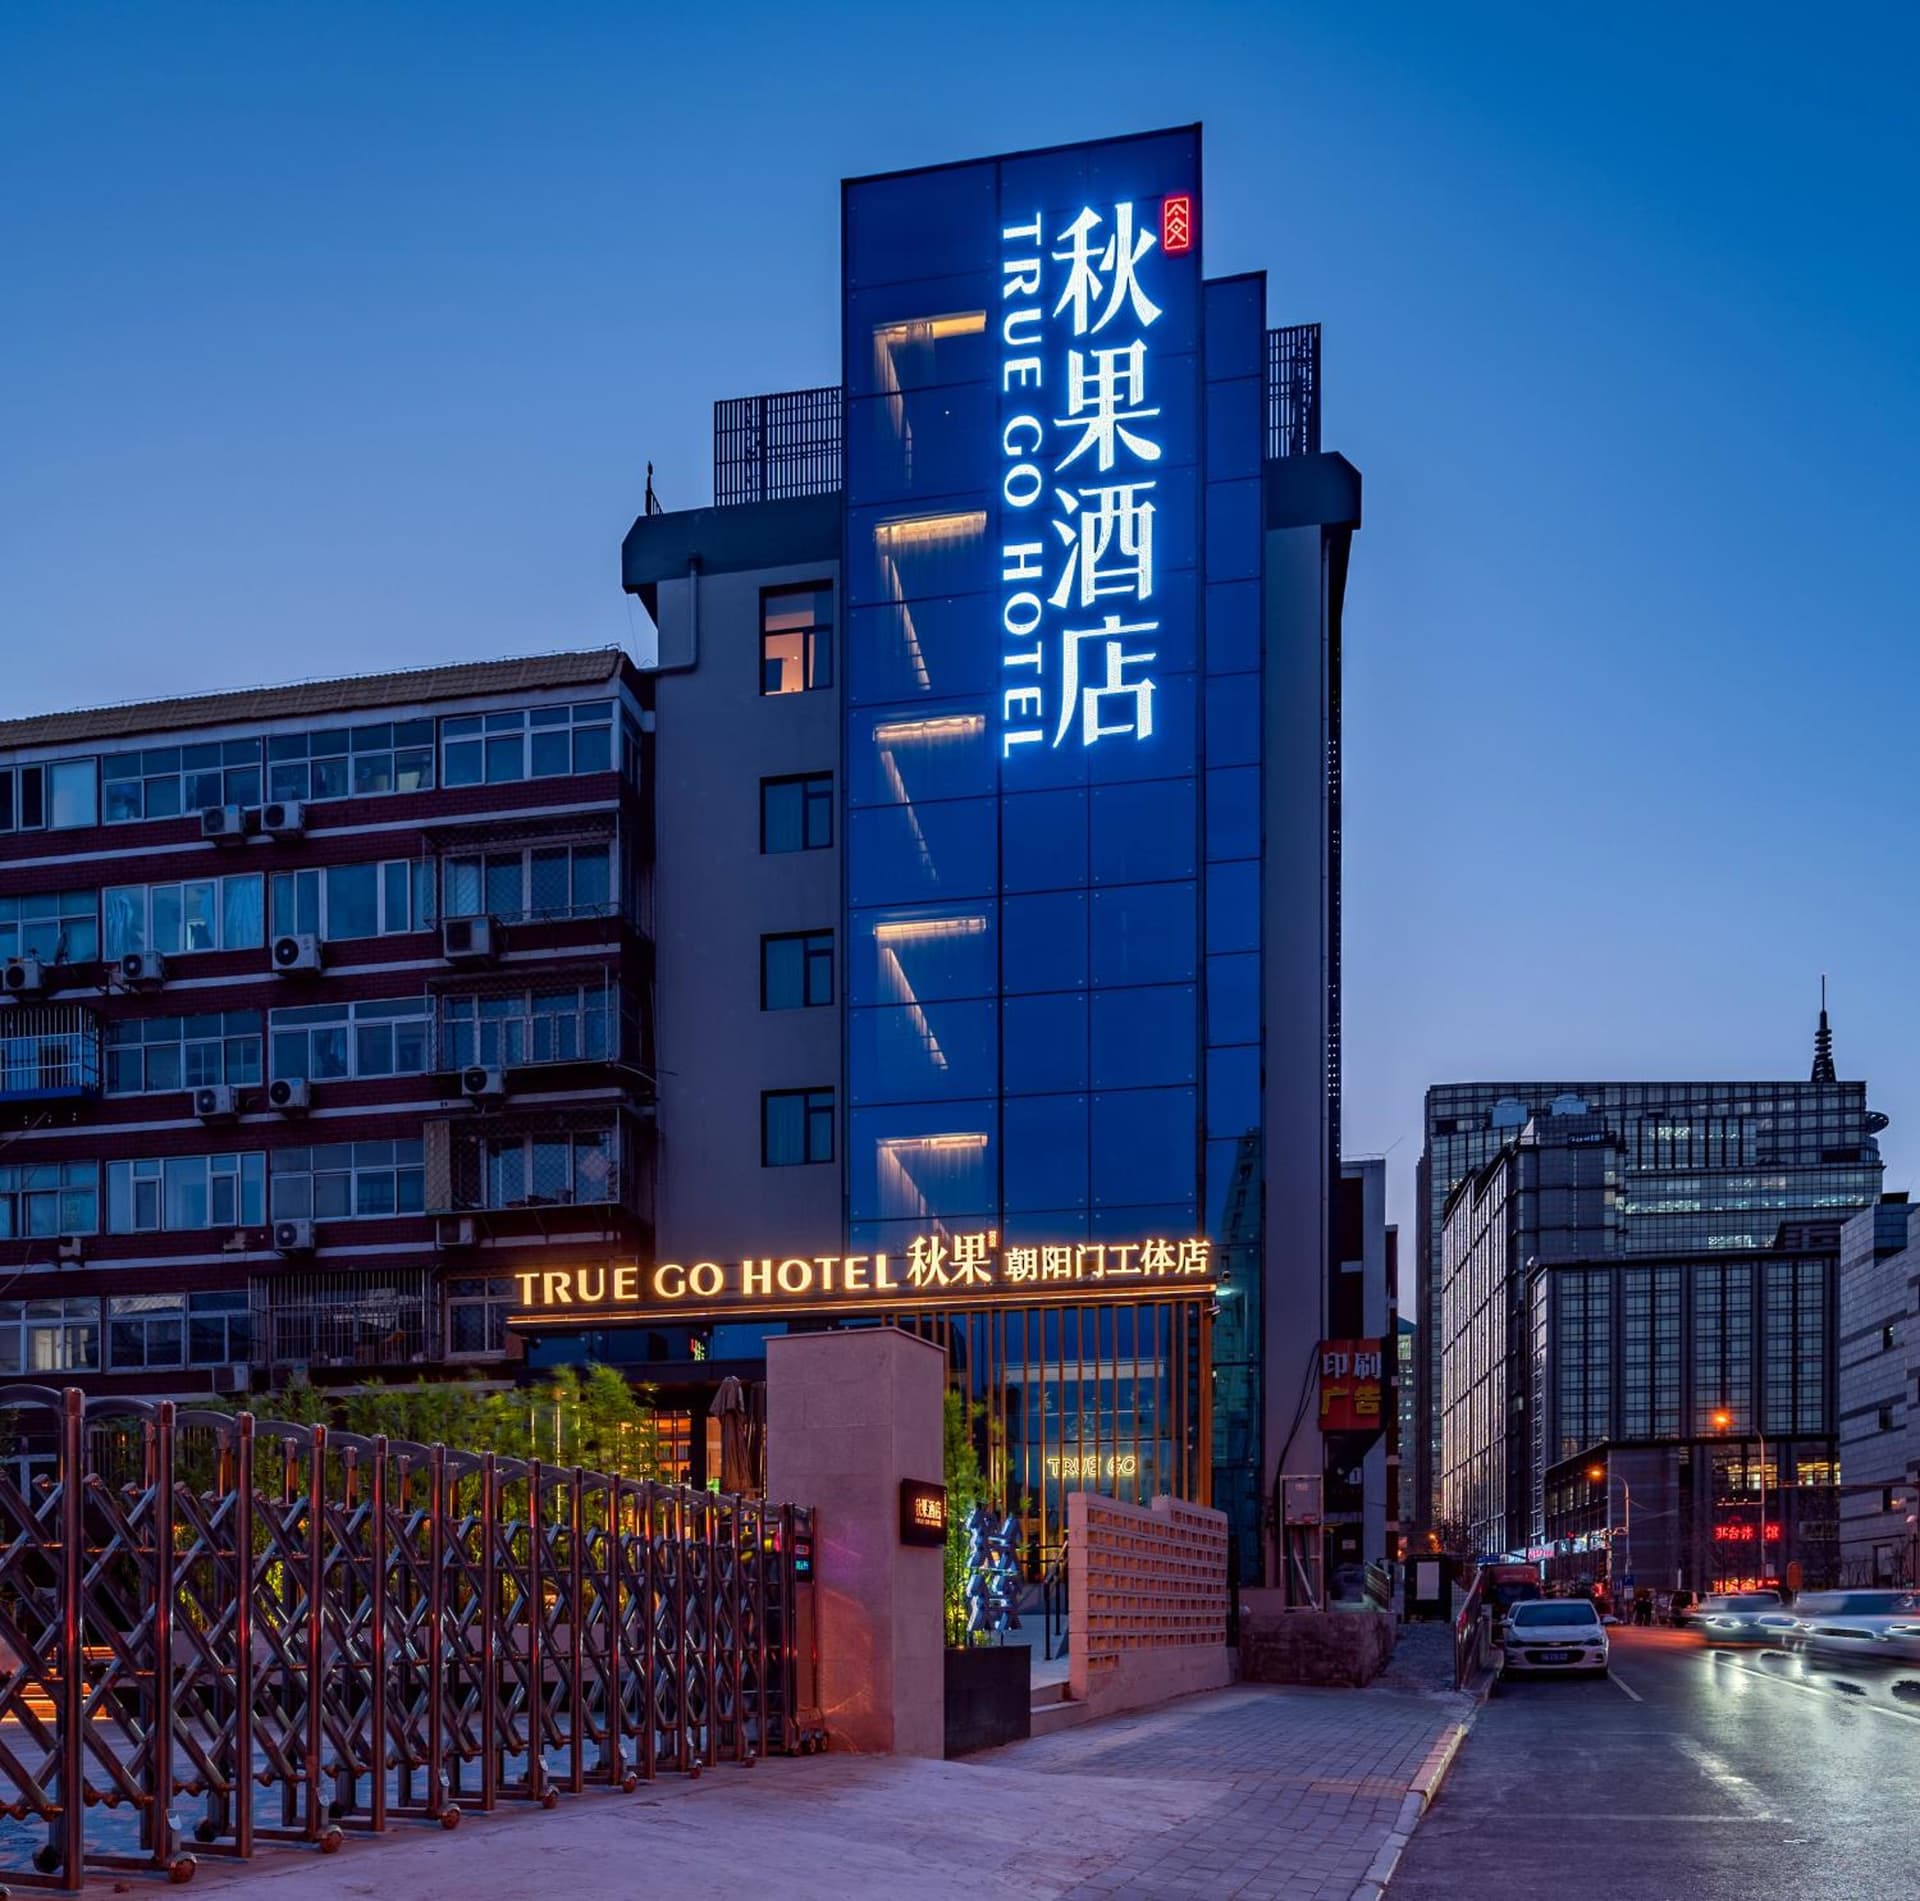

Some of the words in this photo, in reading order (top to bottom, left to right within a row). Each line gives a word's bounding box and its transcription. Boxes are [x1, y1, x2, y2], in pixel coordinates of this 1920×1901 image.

[1003, 212, 1042, 392] TRUE
[1003, 415, 1043, 507] GO
[1047, 202, 1162, 749] 秋果酒店
[1003, 542, 1044, 757] HOTEL
[515, 1266, 639, 1305] TRUE
[654, 1262, 724, 1298] GO
[742, 1255, 898, 1295] HOTEL
[906, 1233, 992, 1287] 秋果
[1004, 1238, 1211, 1281] 朝阳门工体店
[1322, 1352, 1382, 1379] 印刷
[1047, 1456, 1100, 1478] TRUE
[1107, 1455, 1137, 1477] GO
